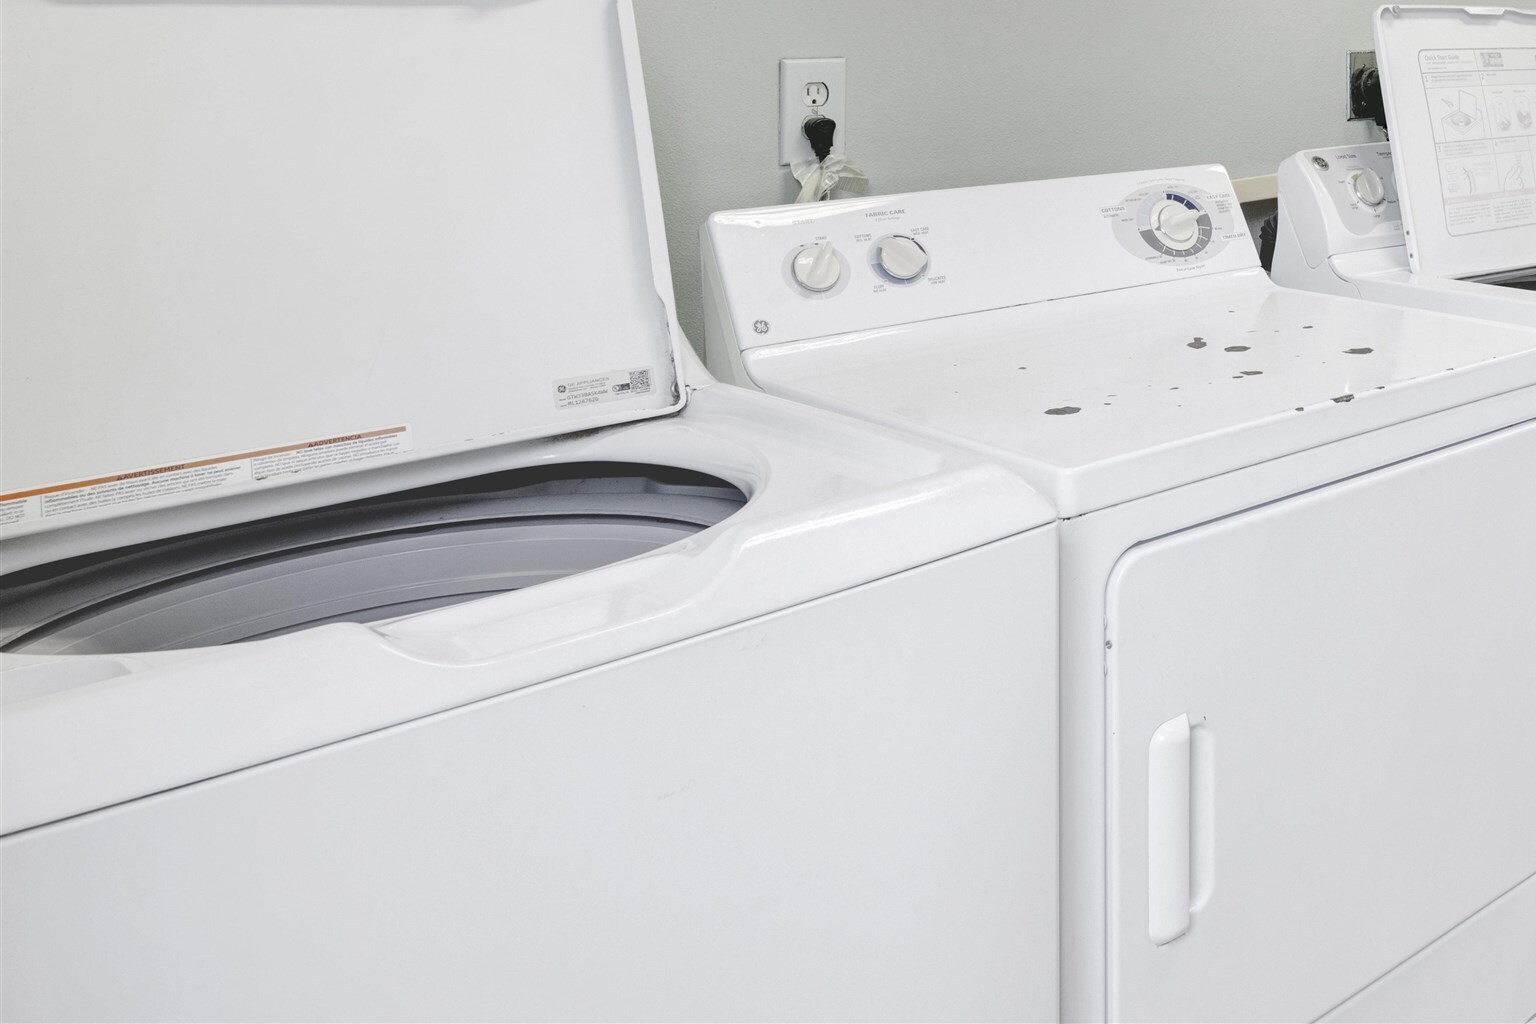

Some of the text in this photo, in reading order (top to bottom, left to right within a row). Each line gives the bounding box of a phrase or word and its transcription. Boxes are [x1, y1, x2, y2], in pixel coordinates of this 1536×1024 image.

[865, 210, 888, 218] FABRIC
[314, 434, 362, 446] ADVERTENCIA
[124, 464, 185, 479] AVERTISSEMENT
